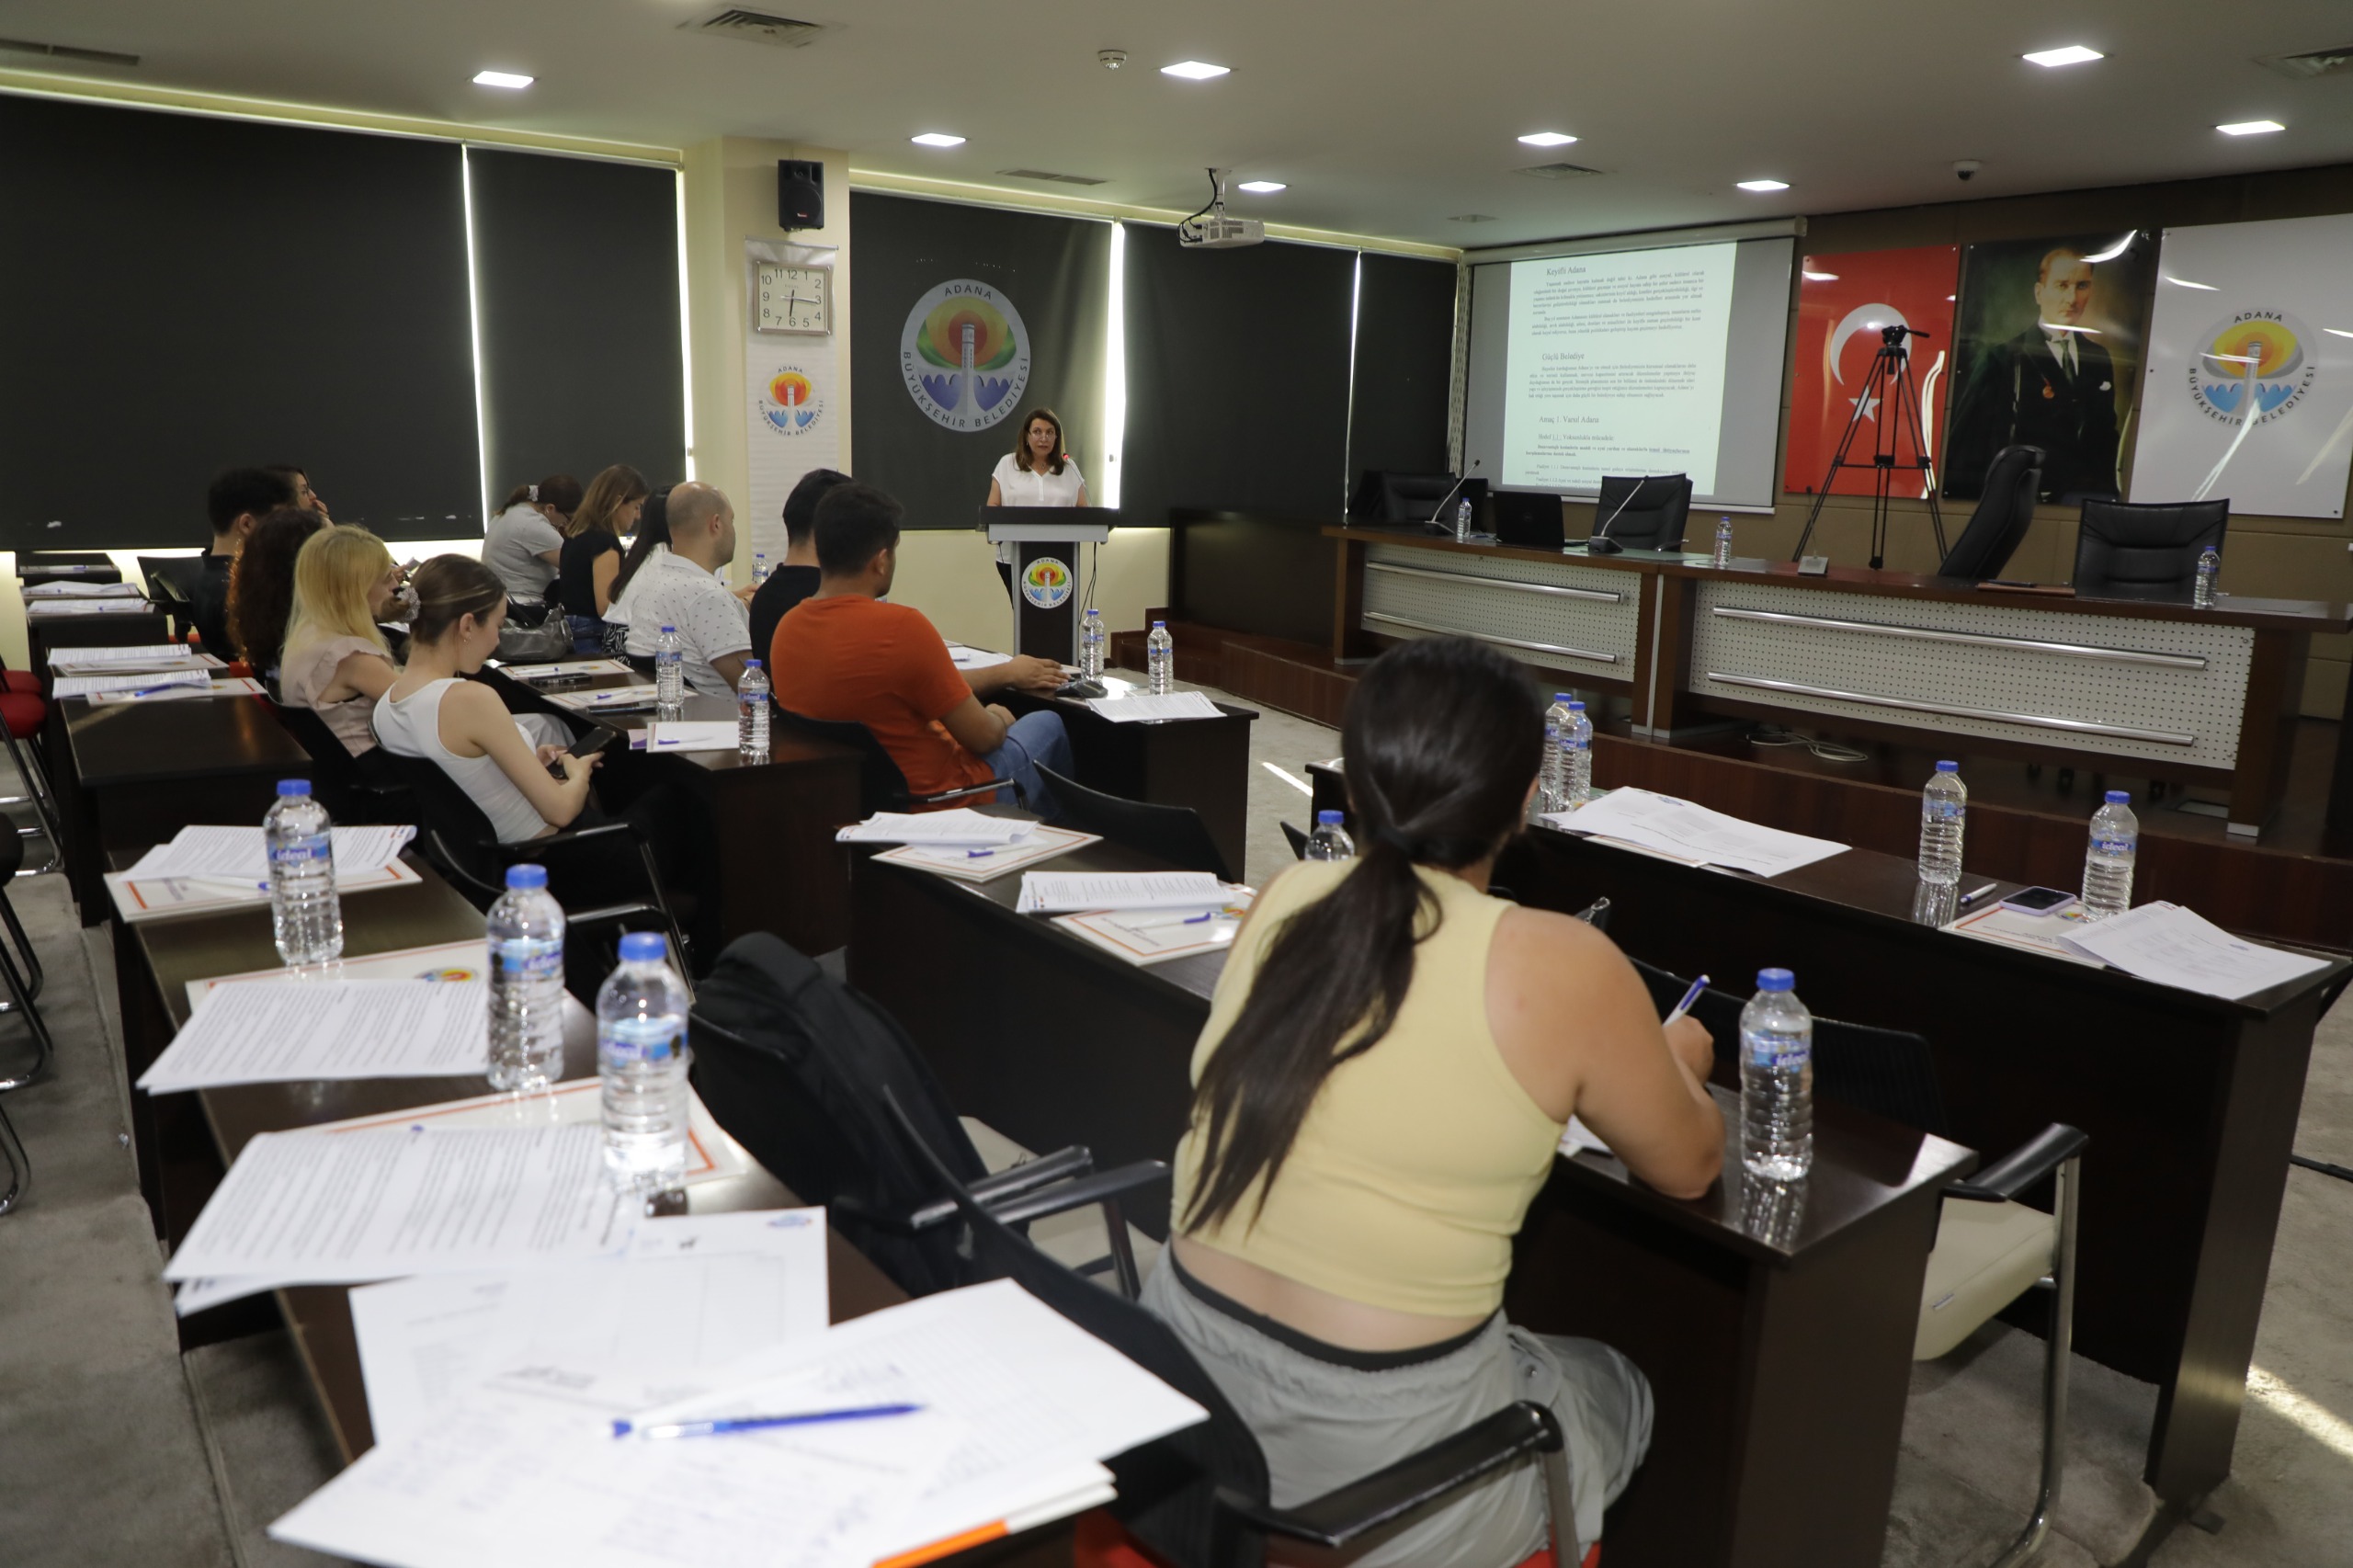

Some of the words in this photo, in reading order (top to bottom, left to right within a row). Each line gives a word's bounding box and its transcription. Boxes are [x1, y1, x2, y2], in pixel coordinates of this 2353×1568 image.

[775, 268, 782, 278] 11
[788, 269, 797, 279] 12
[804, 270, 808, 280] 1
[1546, 267, 1566, 277] Keyifli
[1567, 266, 1586, 274] Adana
[761, 275, 772, 285] 10
[814, 278, 822, 289] 2
[763, 291, 769, 301] 9
[944, 284, 992, 300] ADANA
[814, 295, 822, 304] 3
[763, 308, 770, 318] 8
[814, 312, 822, 321] 4
[2234, 311, 2283, 324] ADANA
[775, 316, 782, 325] 7
[789, 317, 796, 327] 6
[802, 318, 809, 327] 5
[1560, 352, 1585, 361] Belediye
[904, 351, 965, 427] BÜYÜKŞEHİR
[975, 357, 1029, 427] BELEDİYESİ
[2101, 841, 2129, 852] ideal
[277, 847, 313, 861] ideal
